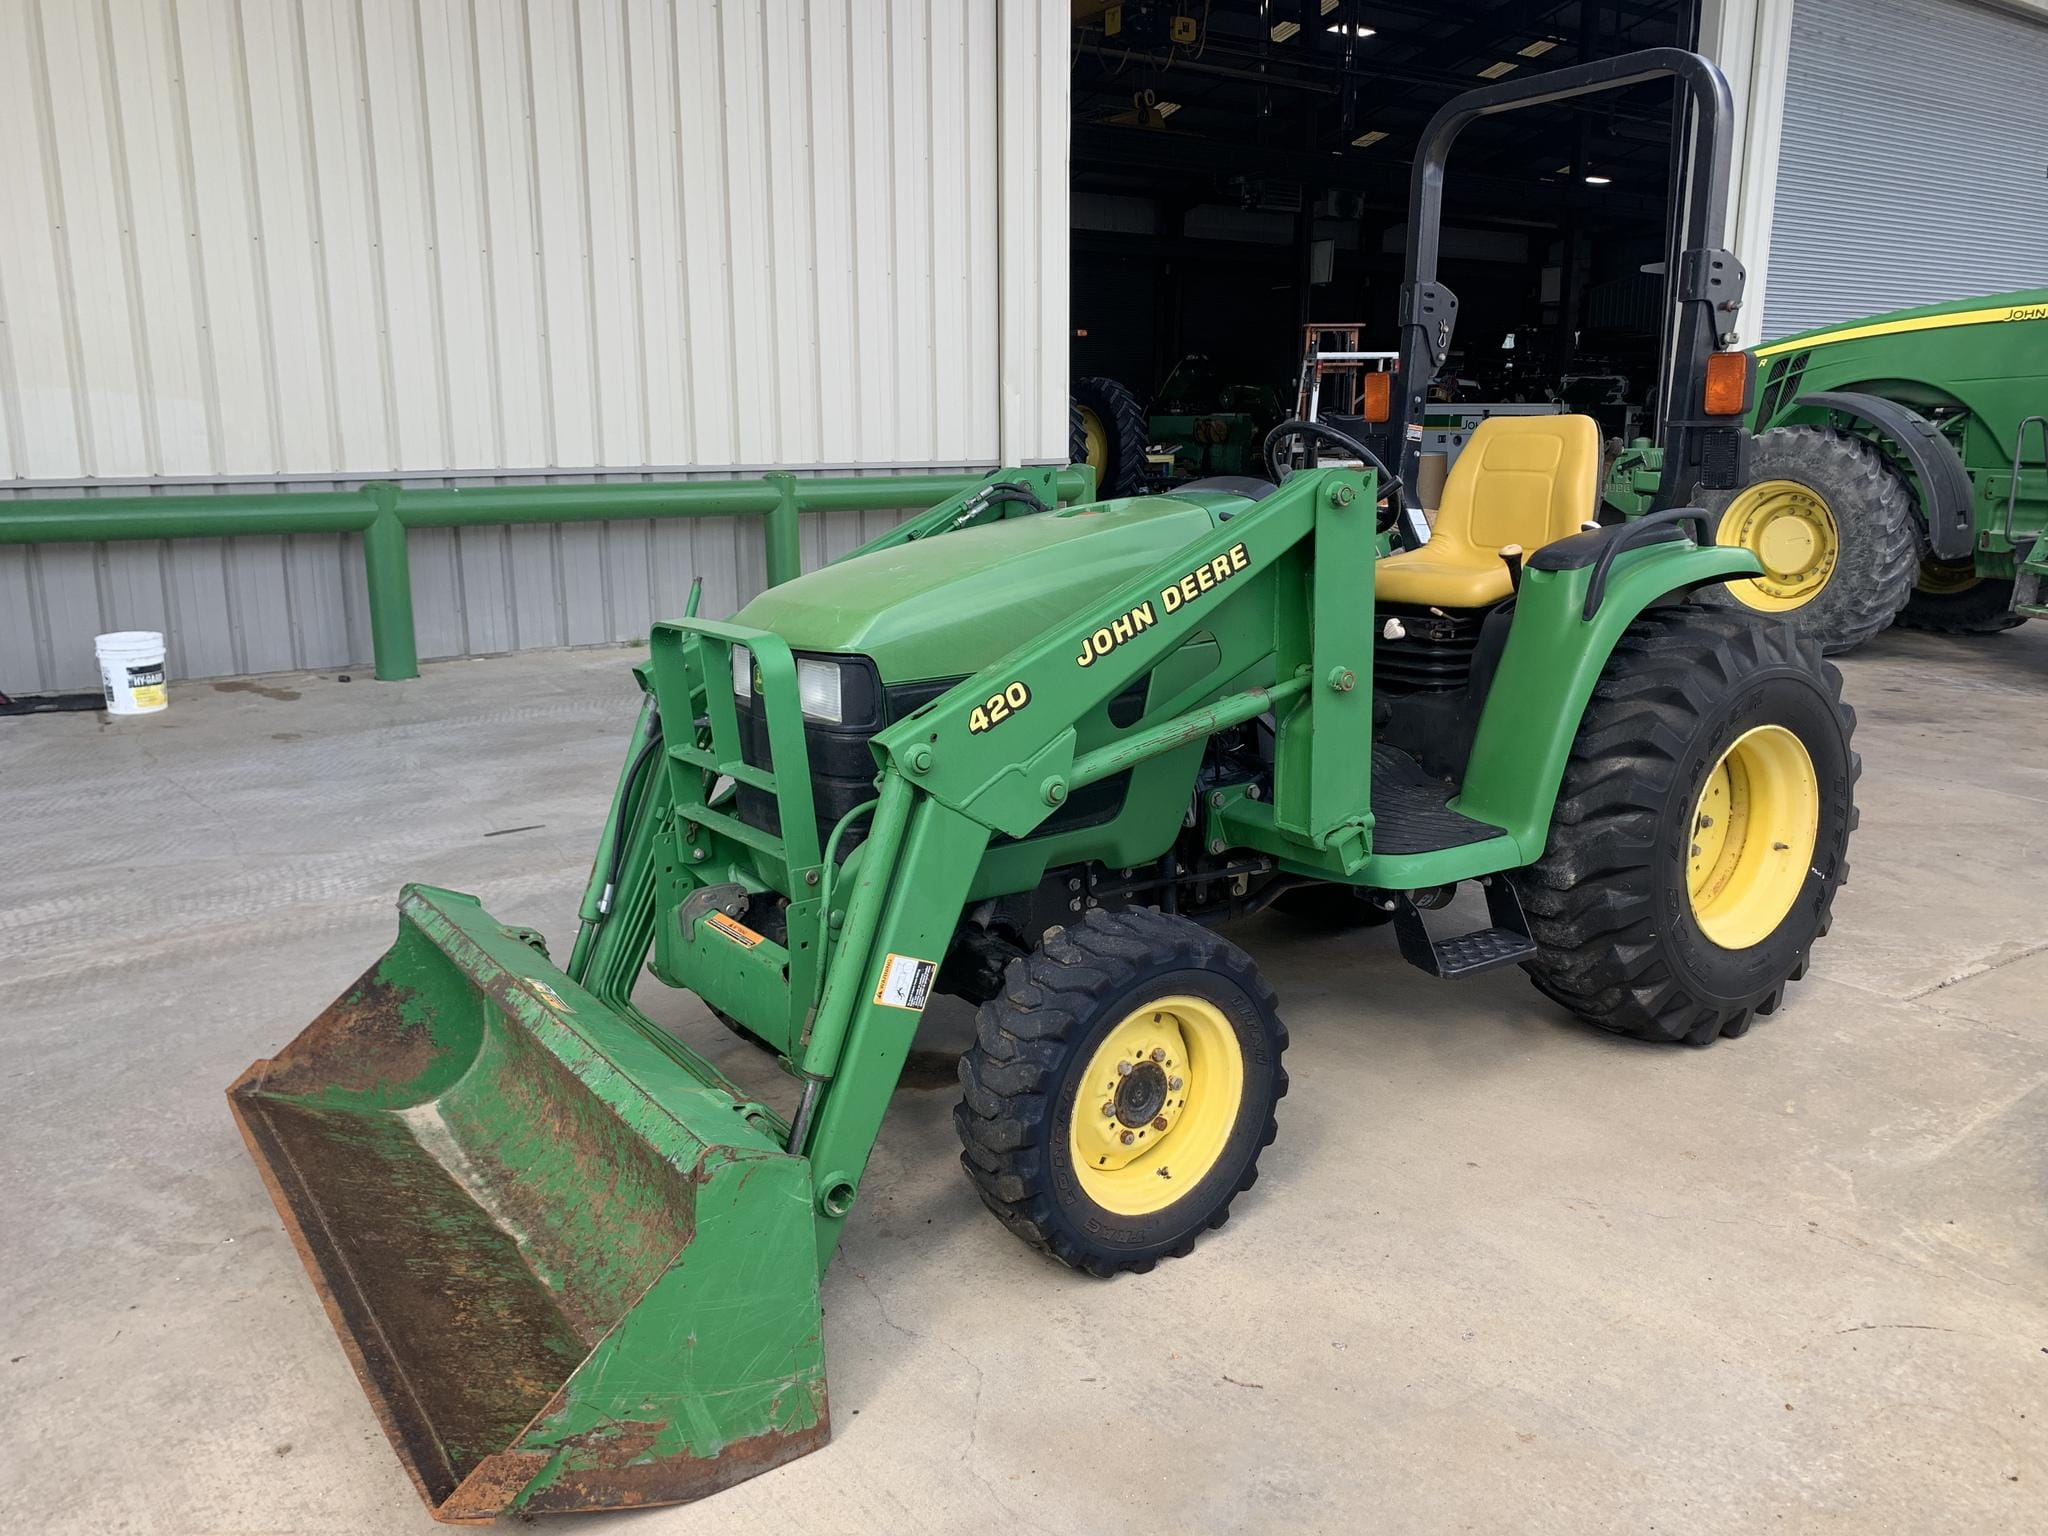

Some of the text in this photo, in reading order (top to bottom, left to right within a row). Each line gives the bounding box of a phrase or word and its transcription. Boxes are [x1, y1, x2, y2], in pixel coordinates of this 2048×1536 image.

[2004, 308, 2047, 320] JOHN
[1076, 542, 1250, 667] JOHN DEERE
[968, 681, 1032, 735] 420
